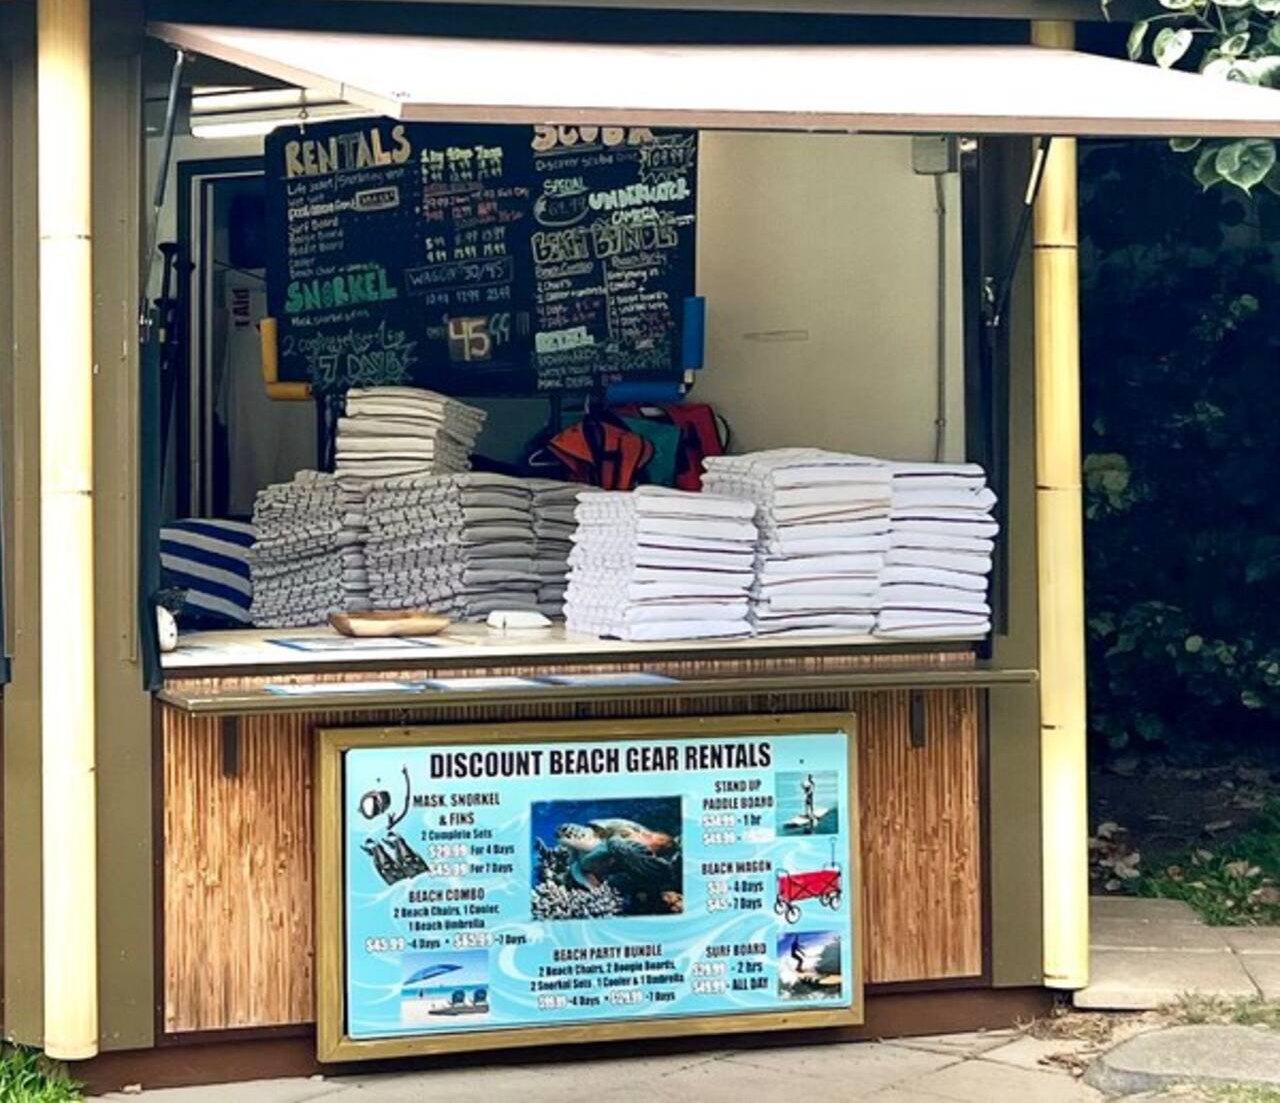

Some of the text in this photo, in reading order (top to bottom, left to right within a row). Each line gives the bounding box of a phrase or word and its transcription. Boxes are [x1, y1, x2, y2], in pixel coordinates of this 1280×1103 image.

[285, 125, 411, 178] RENTALS
[285, 268, 397, 312] SNORKEL
[430, 742, 771, 779] DISCOUNT BEACH GEAR RENTALS
[714, 779, 762, 794] STAND UP
[451, 792, 500, 807] SNORKEL
[703, 796, 774, 810] PADDLE BOARD
[439, 812, 475, 826] & FINS
[421, 829, 493, 841] 2 Complete Sets
[493, 844, 515, 855] Days
[492, 863, 513, 874] Days
[702, 860, 772, 875] BEACH WAGON
[742, 881, 764, 893] Days
[409, 887, 485, 903] BEACH COMBO
[740, 898, 762, 910] Days
[401, 906, 429, 918] Beach
[414, 919, 442, 931] Beach
[444, 918, 485, 930] Umbrella
[418, 938, 441, 950] Days
[505, 934, 527, 946] Days
[553, 943, 662, 962] BEACH PARTY BUNDLE
[705, 943, 767, 958] SURF BOARD
[737, 961, 744, 973] 2
[732, 978, 748, 991] ALL
[750, 977, 768, 989] DAY
[579, 995, 600, 1007] Days
[655, 991, 675, 1002] Days
